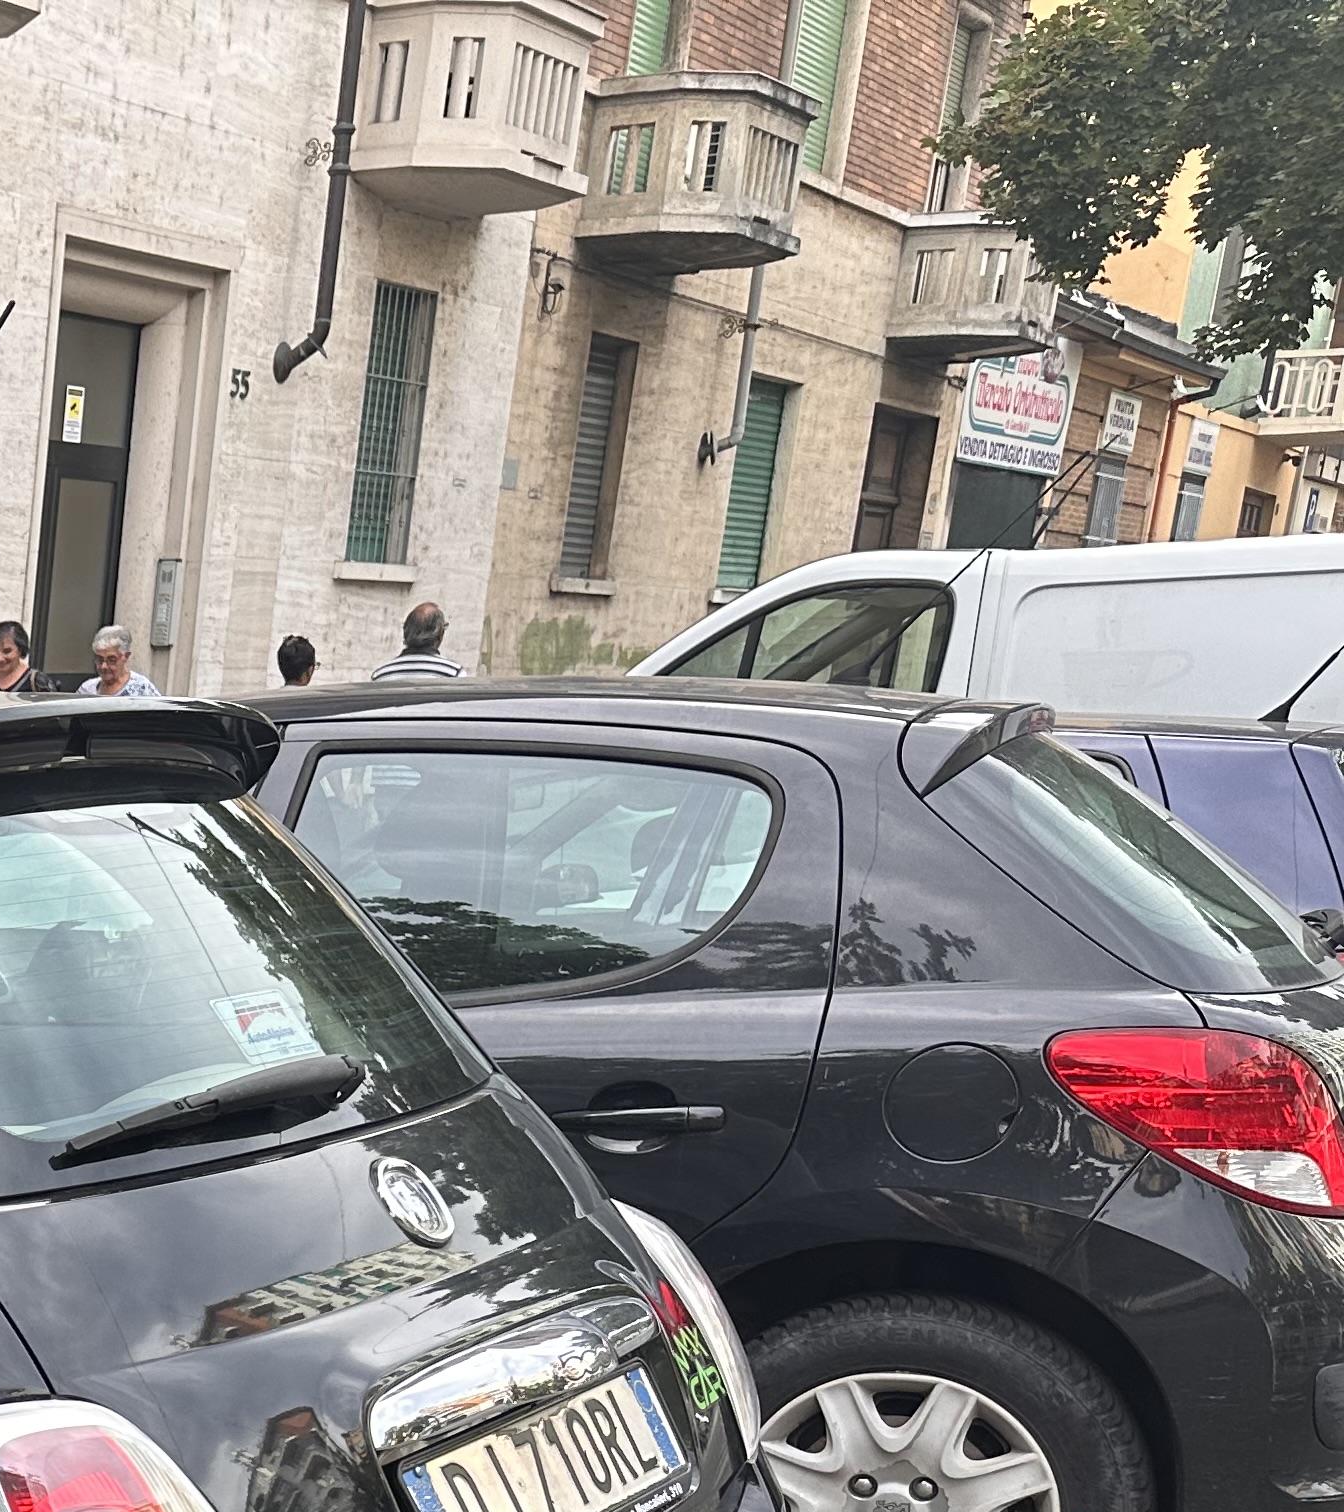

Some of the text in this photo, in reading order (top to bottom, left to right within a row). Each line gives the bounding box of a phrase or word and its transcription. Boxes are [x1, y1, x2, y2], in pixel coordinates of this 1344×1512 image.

[229, 367, 251, 400] 55
[1114, 398, 1135, 416] FRUTTA
[1109, 413, 1135, 432] VERDURA
[959, 435, 1061, 472] VENDITA DETTAGLIO E INGROSSO
